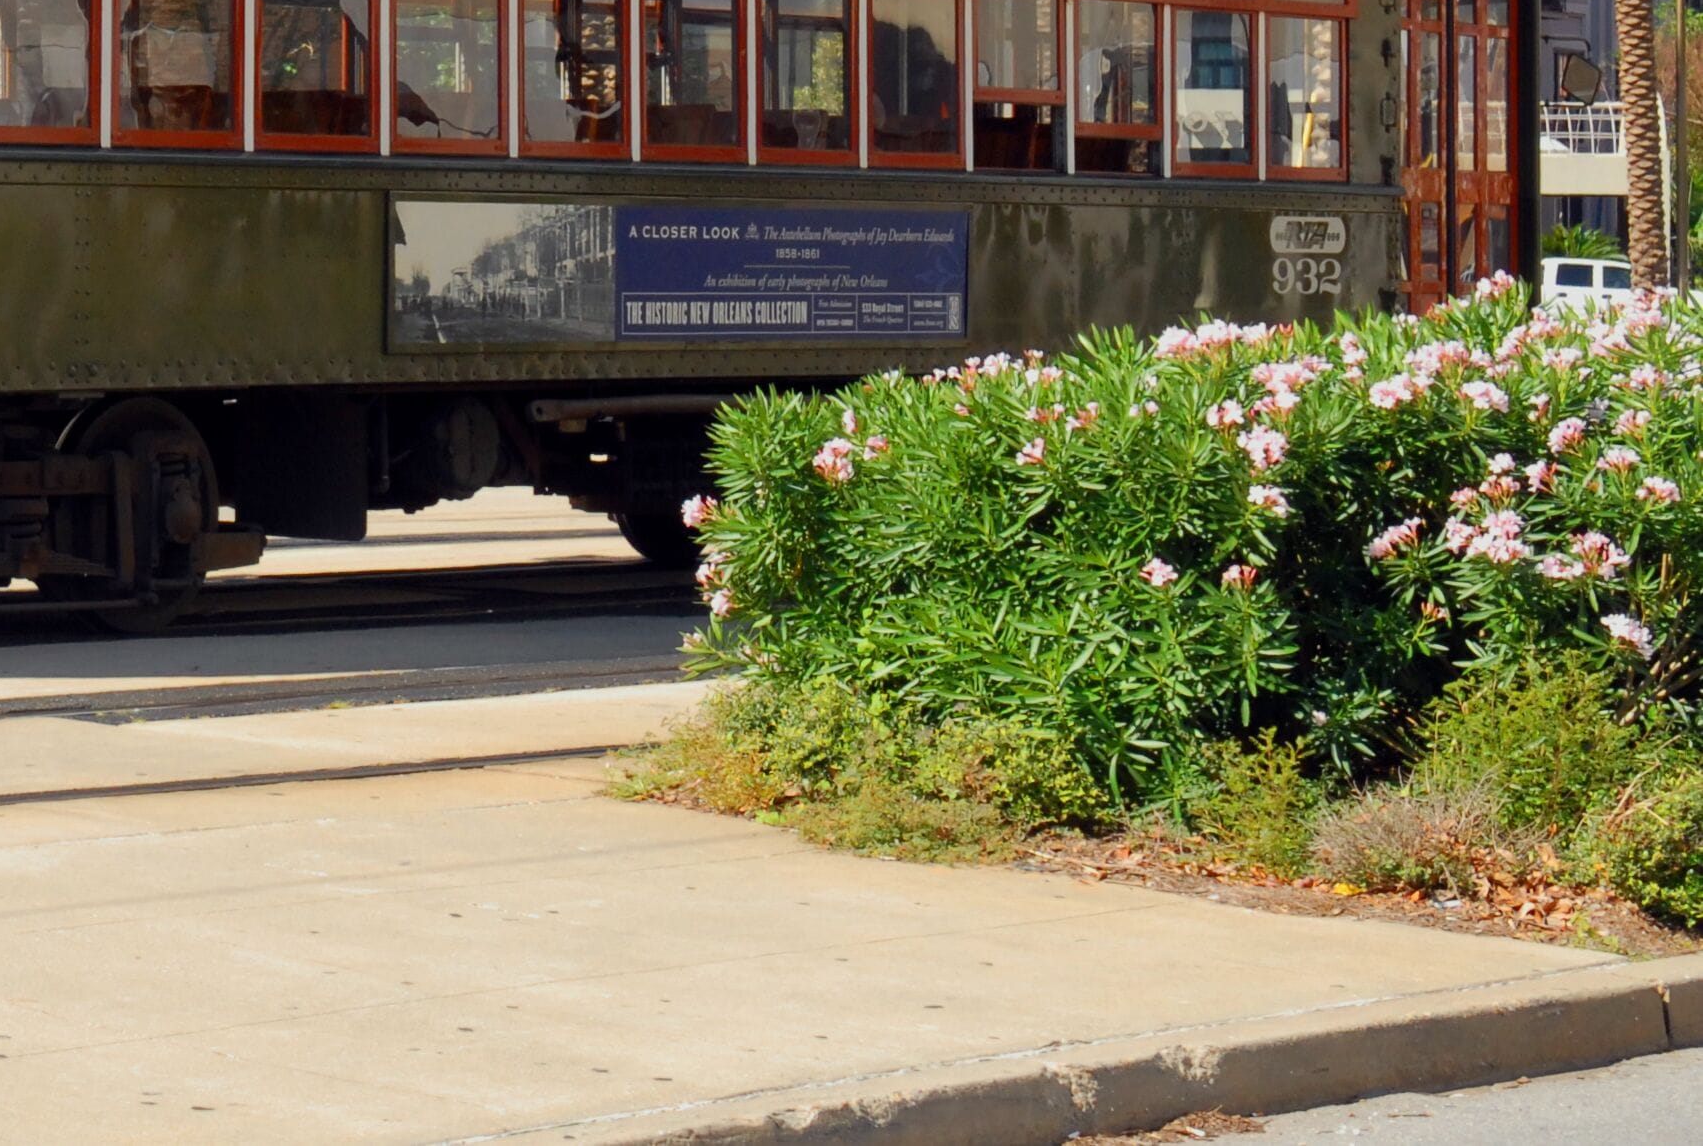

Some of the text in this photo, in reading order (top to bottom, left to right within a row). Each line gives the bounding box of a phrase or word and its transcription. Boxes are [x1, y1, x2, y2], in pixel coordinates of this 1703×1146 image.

[629, 225, 740, 240] A CLOSER LOOK
[763, 226, 778, 241] The
[778, 226, 821, 241] Antebellum
[822, 227, 866, 245] Photographs
[874, 228, 888, 246] Jay
[1285, 220, 1329, 250] RTA
[704, 274, 716, 287] An
[718, 274, 756, 287] exhibition
[768, 274, 785, 290] early
[787, 274, 831, 291] photographs
[832, 274, 843, 291] of
[841, 275, 858, 288] New
[860, 275, 888, 288] Orleans
[1272, 257, 1342, 295] 932
[626, 301, 808, 325] THE HISTORIC NEW ORLEANS COLLECTION
